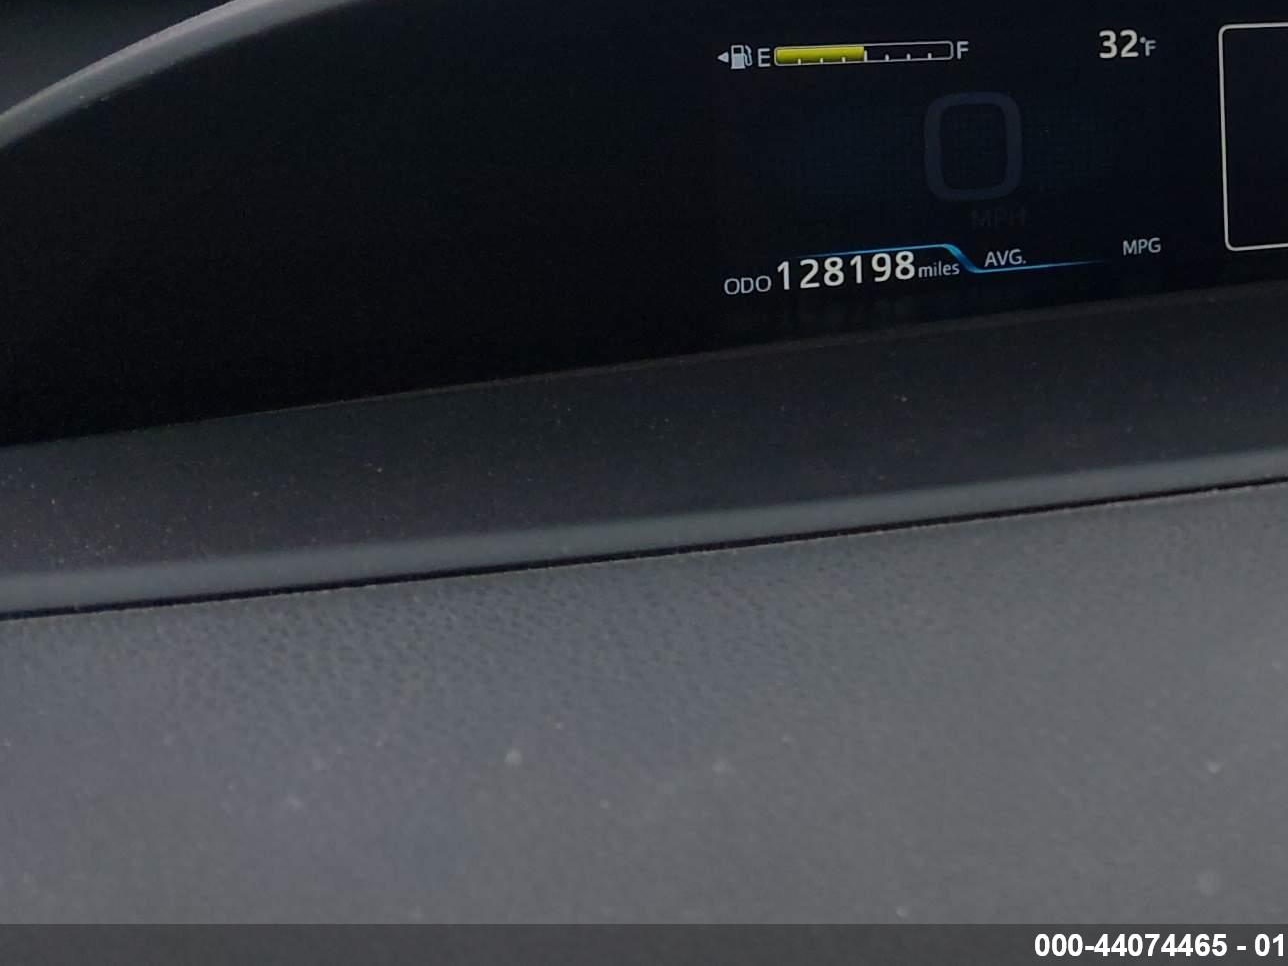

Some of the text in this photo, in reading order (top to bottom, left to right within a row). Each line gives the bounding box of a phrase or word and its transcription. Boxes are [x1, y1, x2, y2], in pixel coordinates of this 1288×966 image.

[757, 40, 969, 68] E F
[983, 248, 1028, 268] AVG.
[1122, 237, 1161, 256] MPG
[723, 249, 961, 295] ODO 128198 miles
